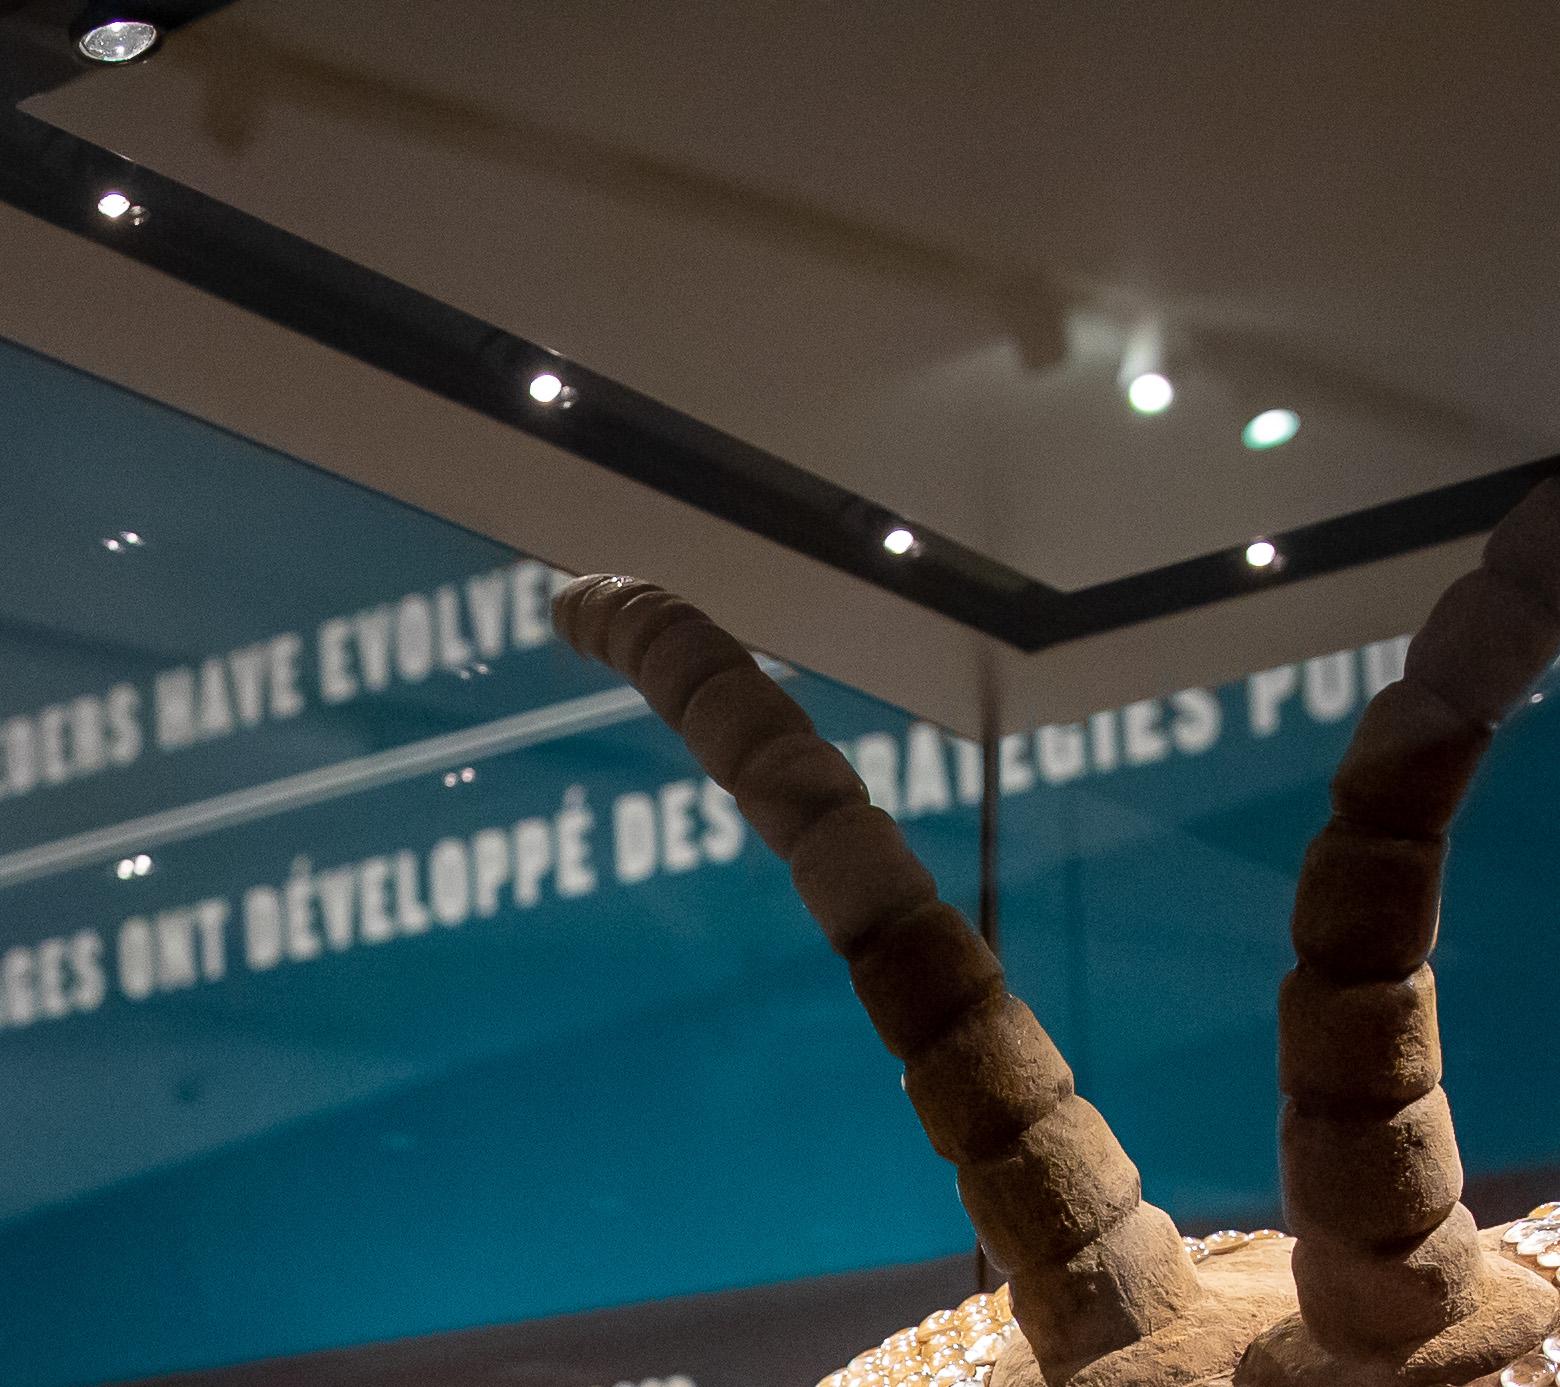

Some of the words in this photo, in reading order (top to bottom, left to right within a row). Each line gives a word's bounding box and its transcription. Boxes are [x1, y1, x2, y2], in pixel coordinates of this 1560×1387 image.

[155, 632, 305, 751] HAVE
[318, 560, 577, 702] EVOLVE
[116, 897, 229, 1000] ONT
[243, 784, 596, 971] DÉVELOPPÉ
[613, 775, 746, 884] DES
